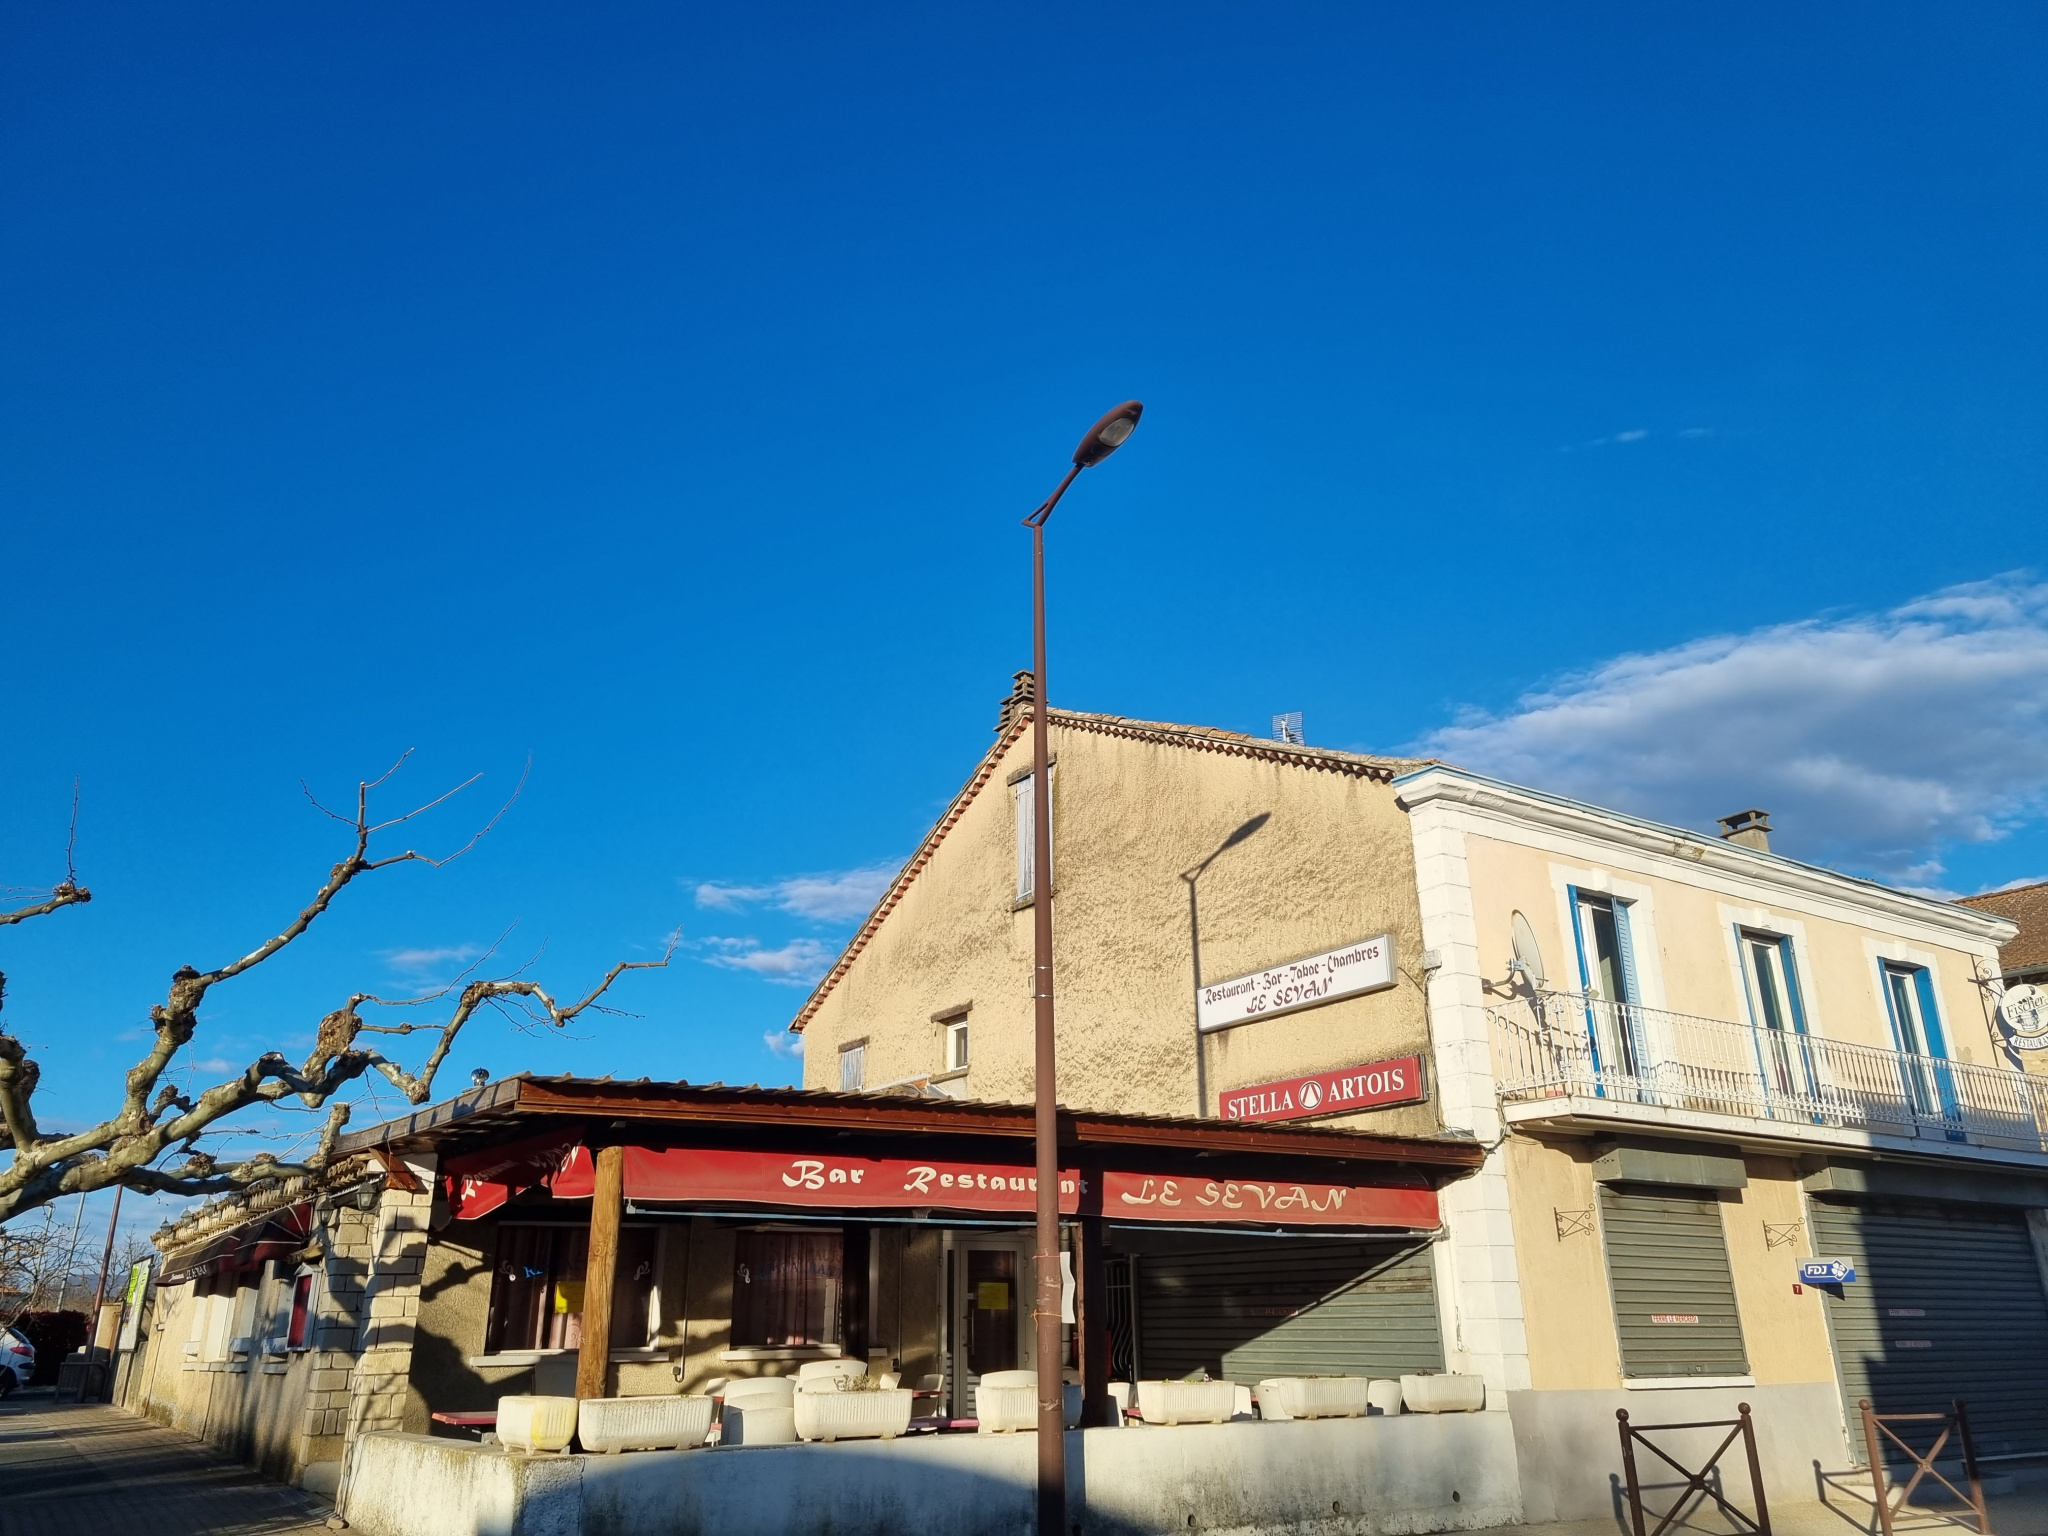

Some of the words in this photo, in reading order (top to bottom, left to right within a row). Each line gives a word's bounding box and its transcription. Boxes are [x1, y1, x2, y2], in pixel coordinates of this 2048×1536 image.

[1205, 978, 1255, 1005] Restaurant
[1263, 972, 1282, 990] Bar
[1290, 962, 1319, 982] Tabac
[1328, 946, 1379, 973] Chambres
[1247, 994, 1267, 1013] LE
[1273, 976, 1333, 1007] SEVAN
[2006, 995, 2045, 1018] Fischer
[1228, 1090, 1294, 1119] STELLA
[1328, 1068, 1405, 1103] ARTOIS
[782, 1160, 864, 1190] Bar
[903, 1166, 1088, 1194] Restaurnt
[1121, 1180, 1181, 1206] LE
[1195, 1182, 1347, 1211] SEVAN
[1807, 1265, 1827, 1275] FDJ
